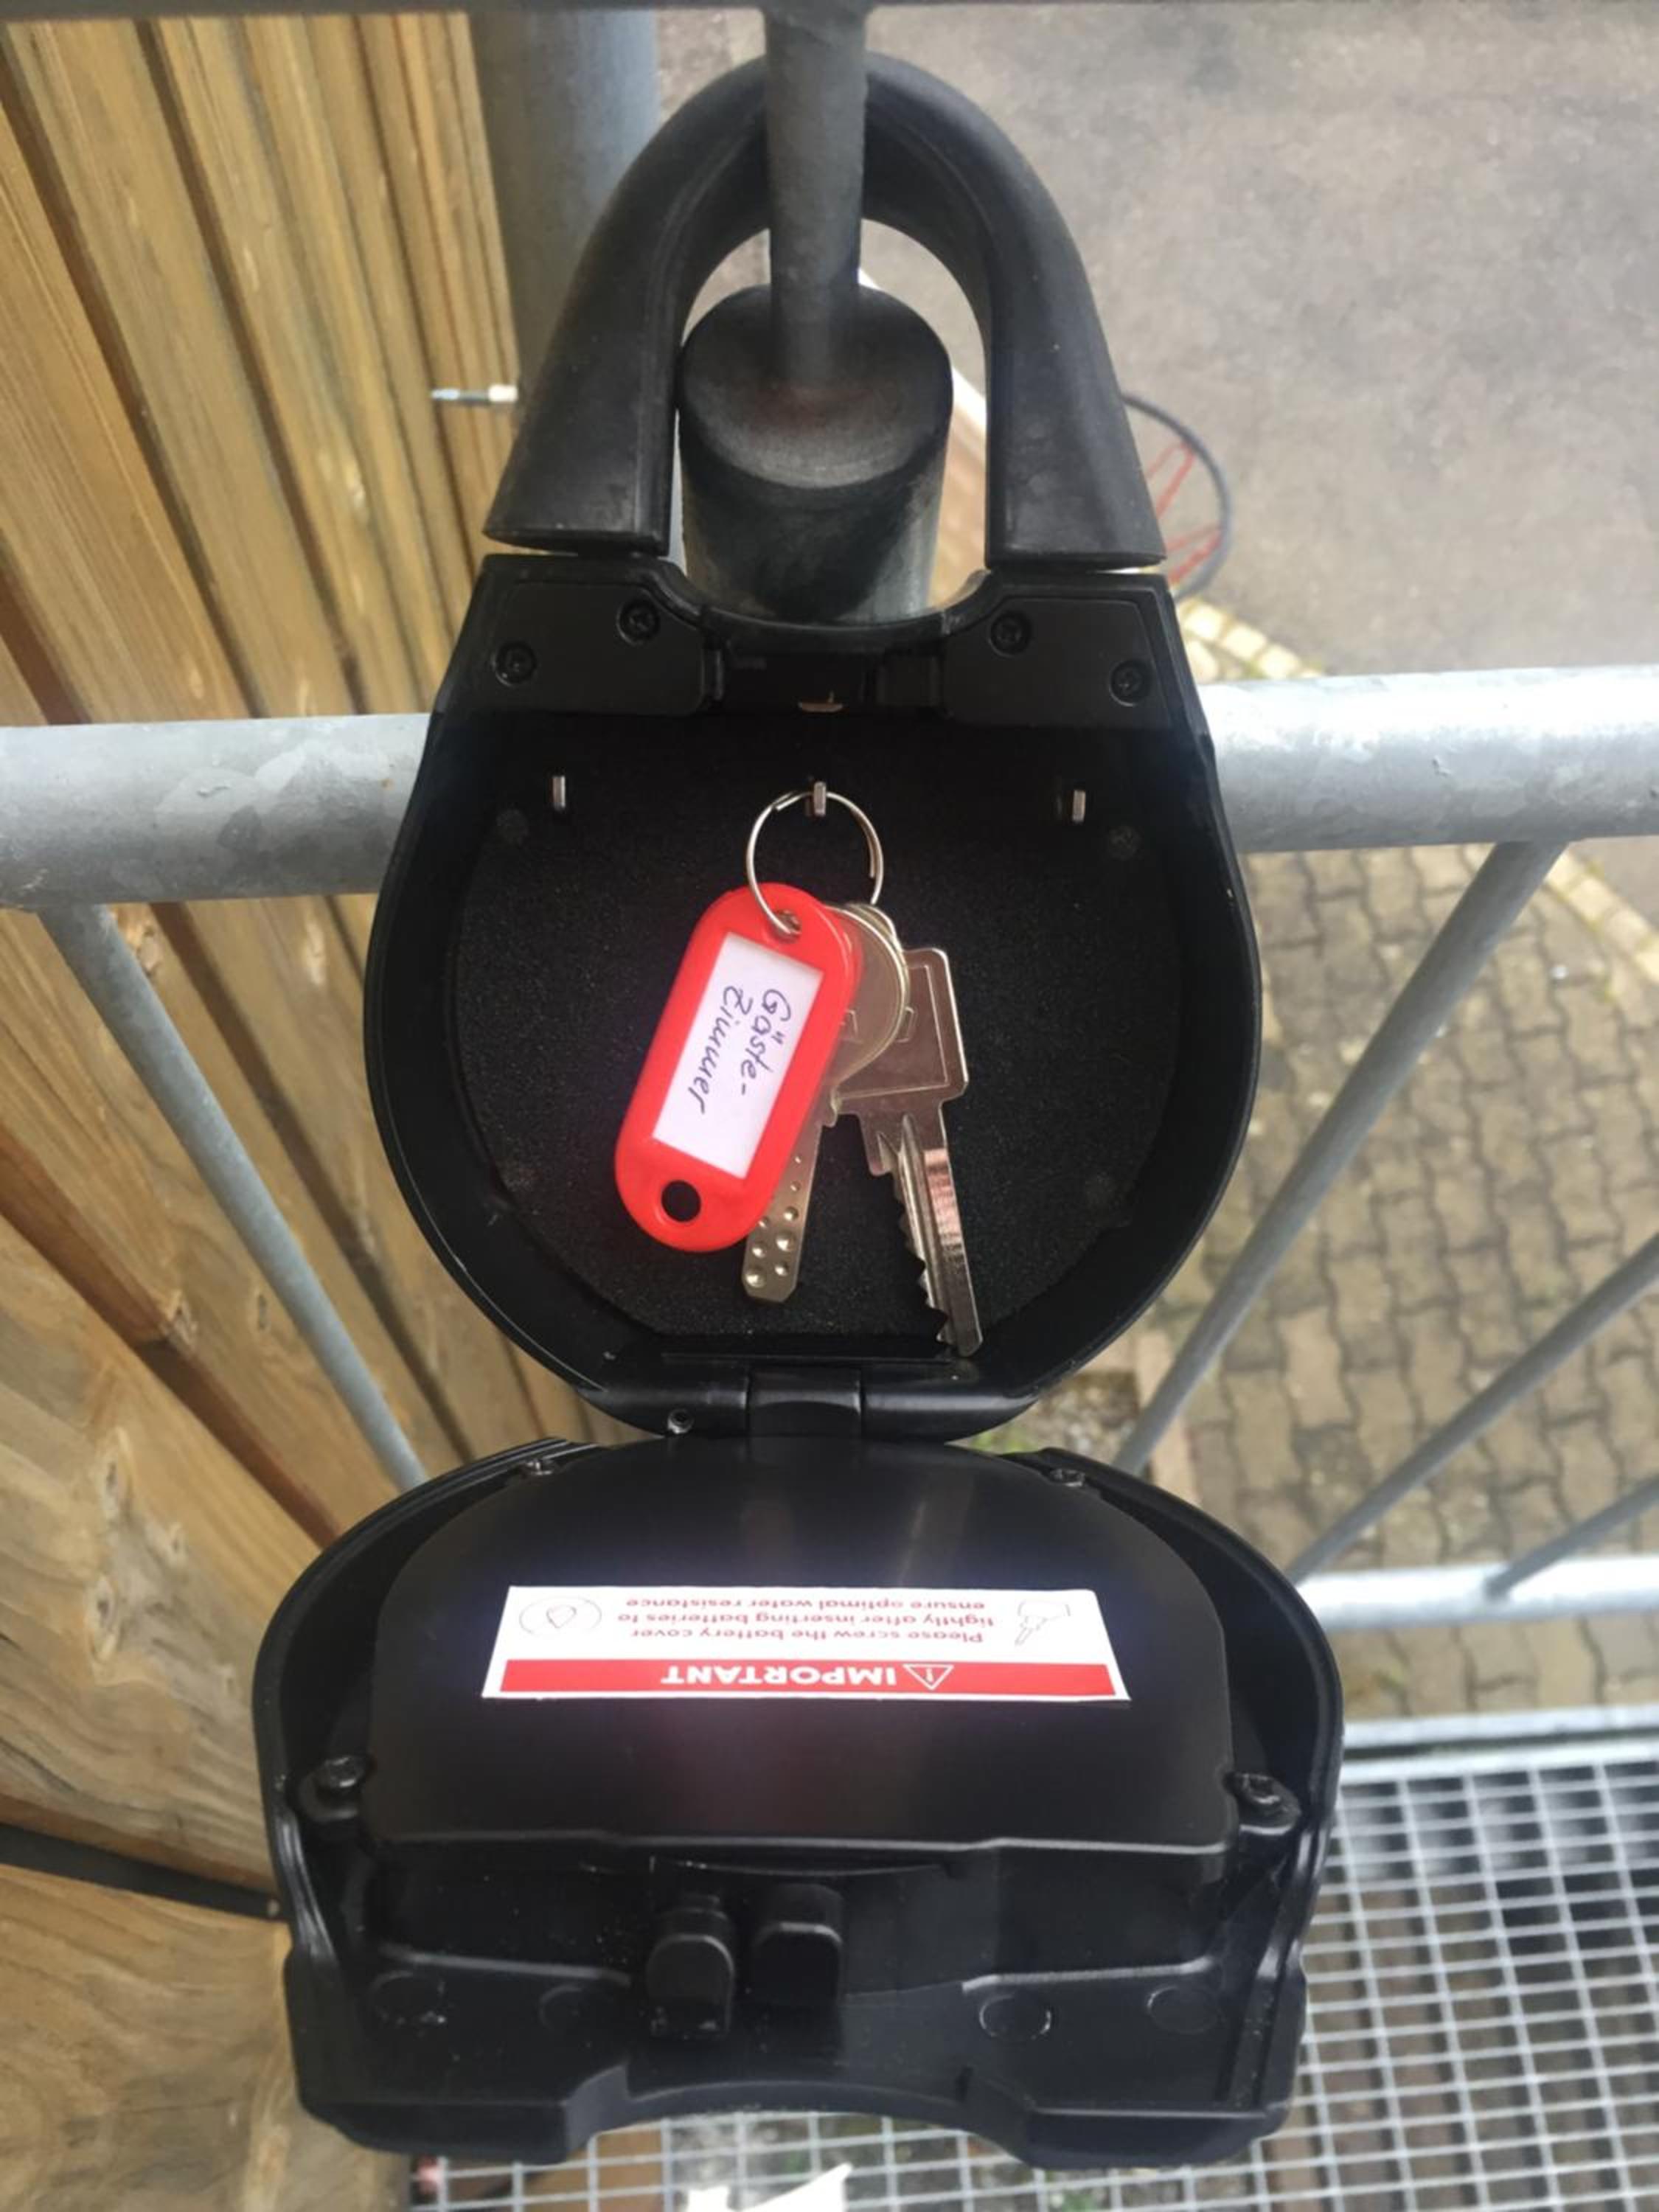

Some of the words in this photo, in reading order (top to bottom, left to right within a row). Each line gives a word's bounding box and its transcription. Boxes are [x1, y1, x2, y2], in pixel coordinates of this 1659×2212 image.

[740, 989, 791, 1096] Gäste-
[626, 1599, 741, 1607] resistance
[749, 1599, 812, 1609] water
[820, 1598, 902, 1610] optimal
[911, 1601, 984, 1610] ensure
[618, 1614, 639, 1624] to
[647, 1614, 748, 1625] batteries
[757, 1613, 855, 1625] inserting
[862, 1615, 916, 1626] after
[923, 1615, 993, 1627] tightly
[631, 1630, 692, 1638] cover
[699, 1628, 783, 1640] battery
[792, 1630, 827, 1641] the
[835, 1630, 900, 1639] screw
[907, 1632, 984, 1643] Please
[661, 1666, 897, 1686] IMPORTANT
